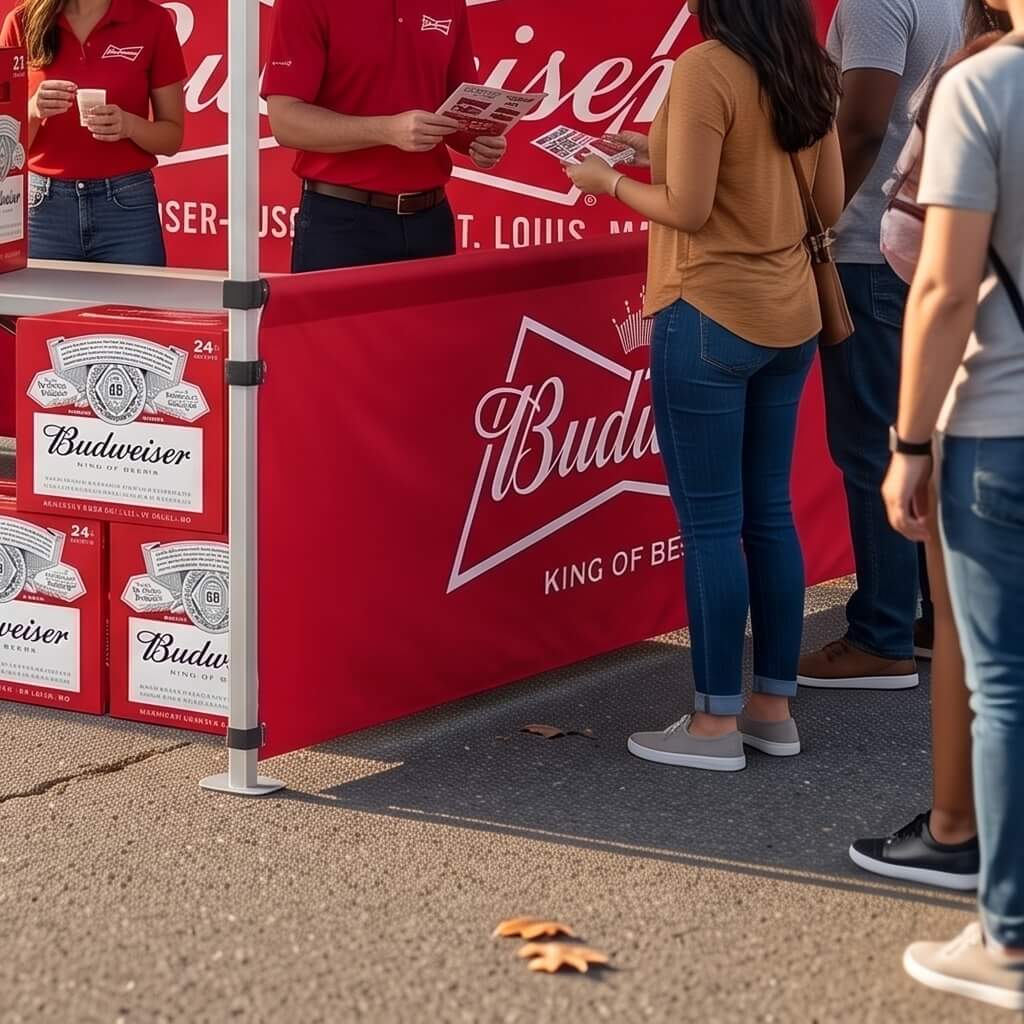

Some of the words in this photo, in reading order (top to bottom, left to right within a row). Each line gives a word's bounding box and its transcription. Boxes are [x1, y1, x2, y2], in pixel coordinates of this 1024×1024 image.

[193, 339, 214, 354] 24
[43, 424, 191, 465] Budweiser
[71, 524, 90, 538] 24
[544, 557, 603, 595] KING
[612, 546, 644, 576] OF
